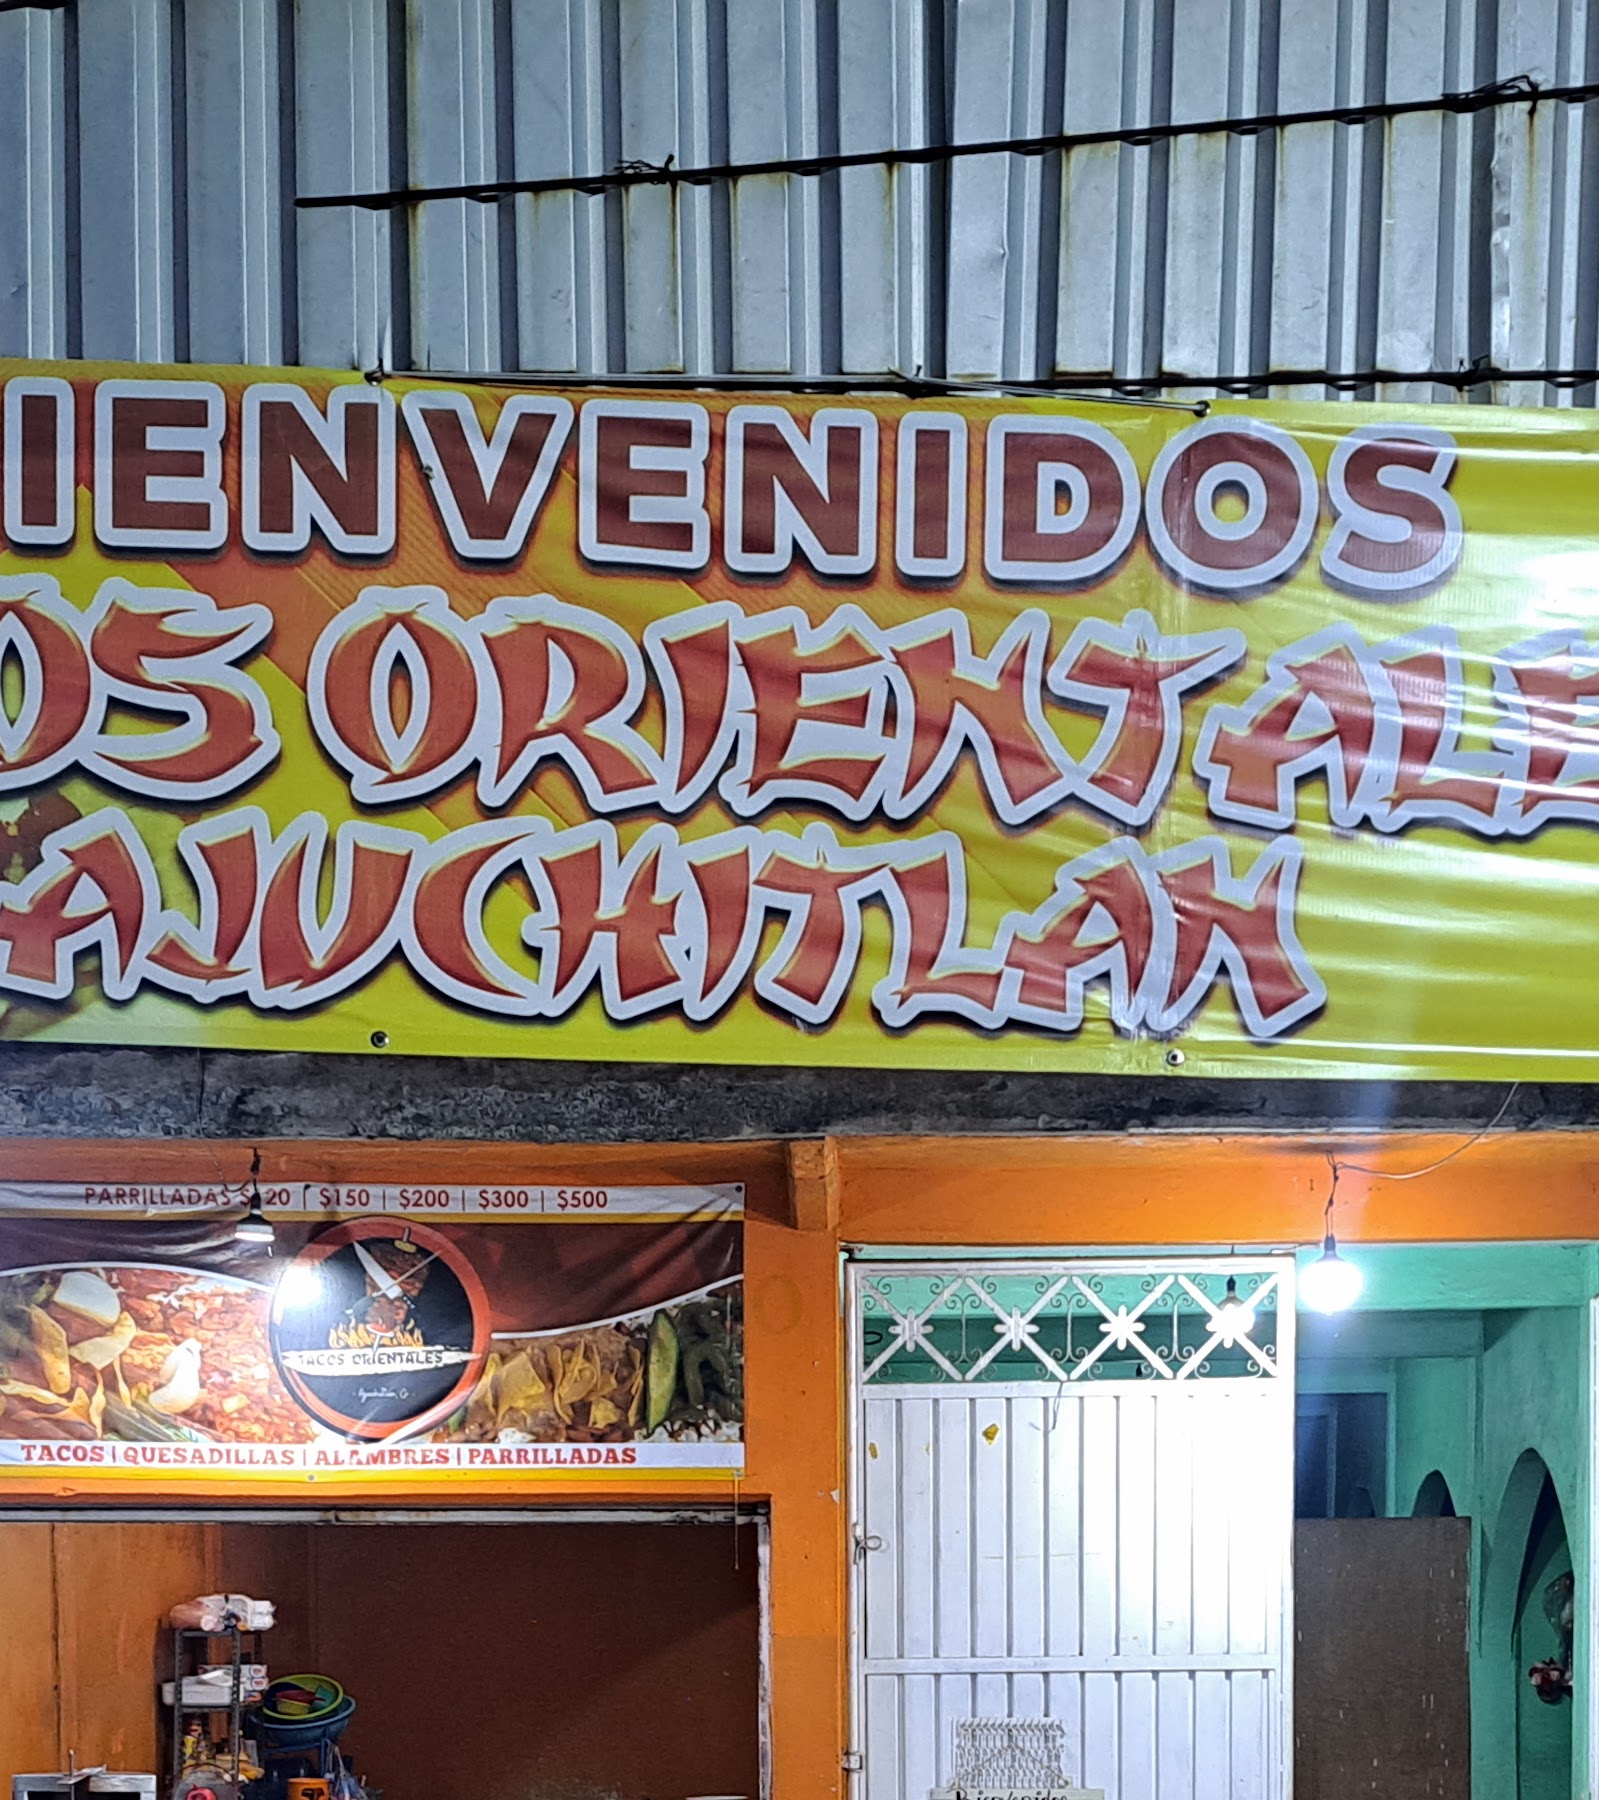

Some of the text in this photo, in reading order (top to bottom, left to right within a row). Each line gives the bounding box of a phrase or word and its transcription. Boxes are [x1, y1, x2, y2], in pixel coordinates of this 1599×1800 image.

[84, 1187, 608, 1211] PARRILLADAS $20 $150 $200 $300 $500
[21, 1443, 637, 1466] TACOS QUESADILLAS ALAMBRES PARRILLADAS
